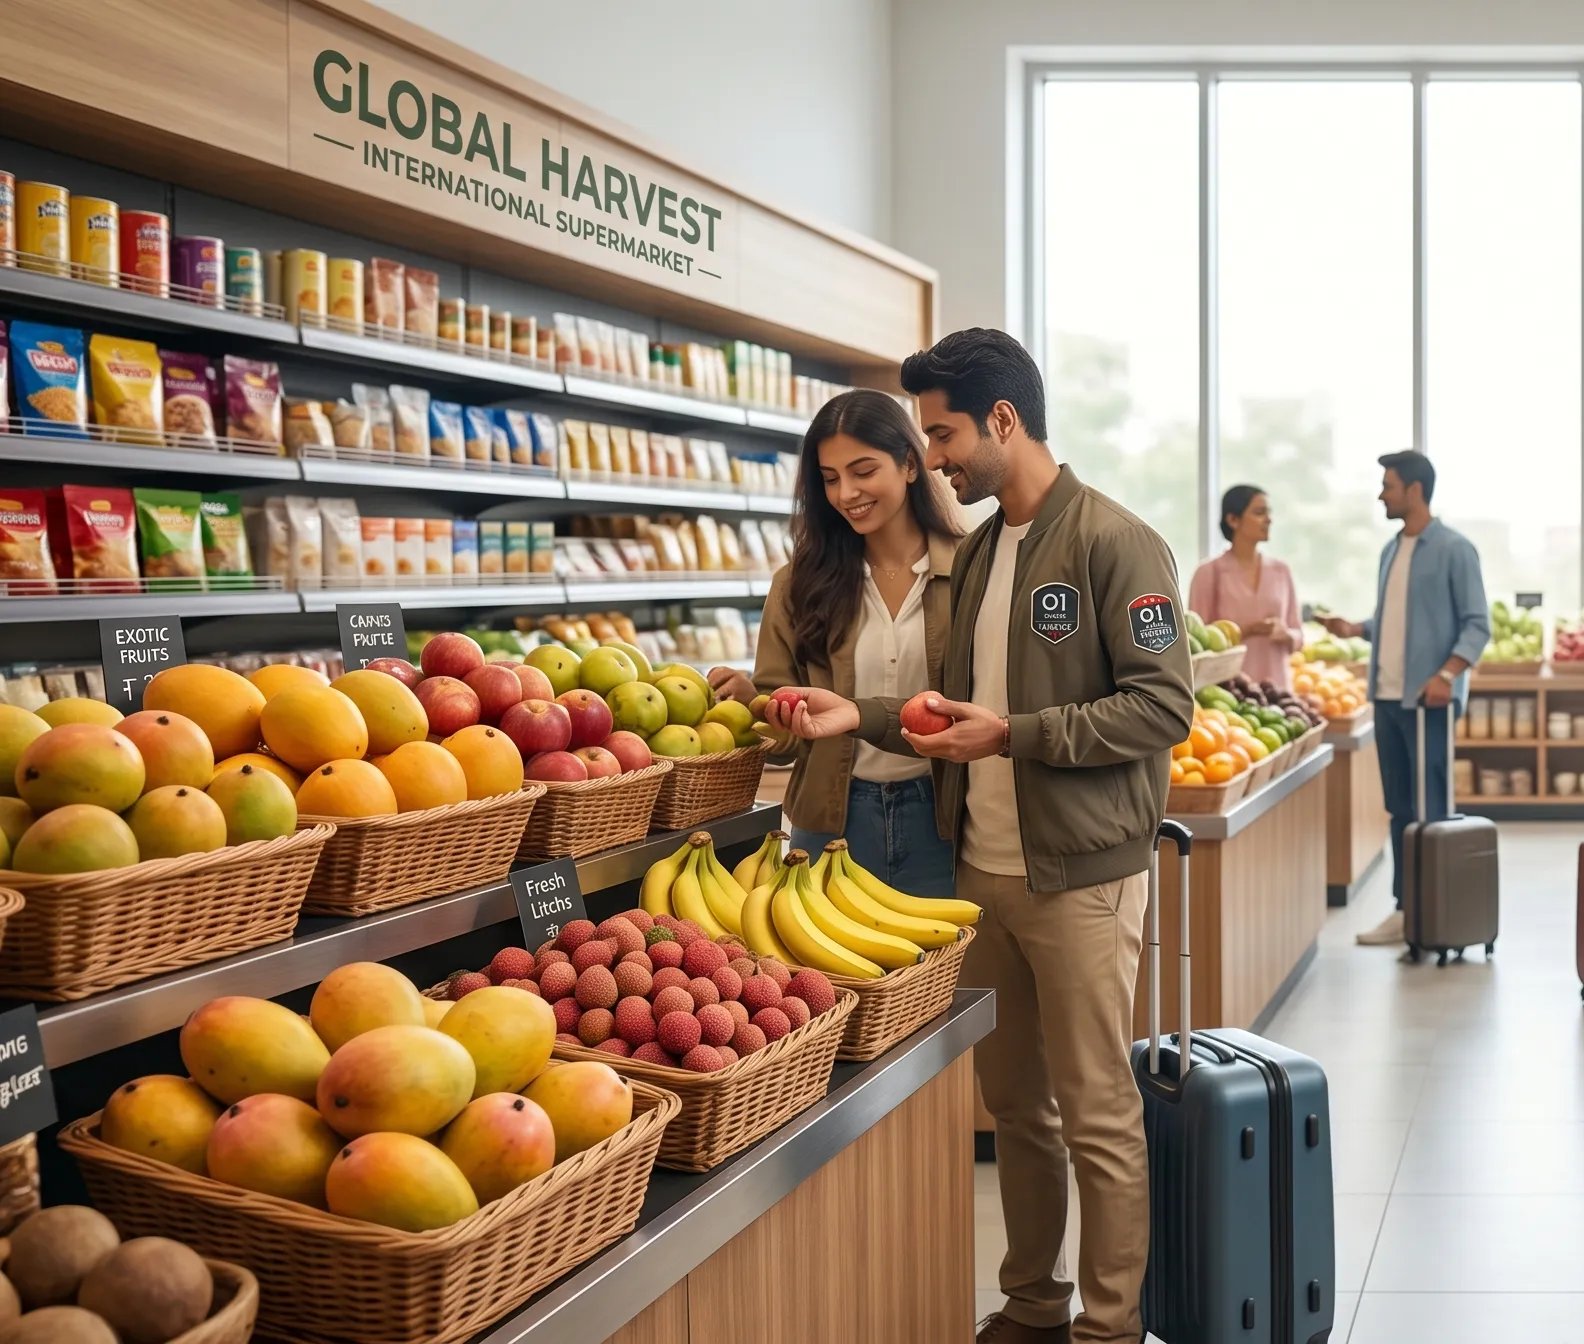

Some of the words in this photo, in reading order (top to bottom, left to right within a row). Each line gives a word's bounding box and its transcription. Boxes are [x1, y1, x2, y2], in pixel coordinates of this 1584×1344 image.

[313, 49, 527, 183] GLOBAL
[541, 138, 722, 253] HARVEST
[363, 140, 551, 229] INTERNATIONAL
[556, 210, 694, 277] SUPERMARKET
[115, 627, 170, 645] EXOTIC
[120, 647, 169, 664] FRUITS
[525, 872, 566, 897] Fresh
[531, 896, 572, 920] Litchs
